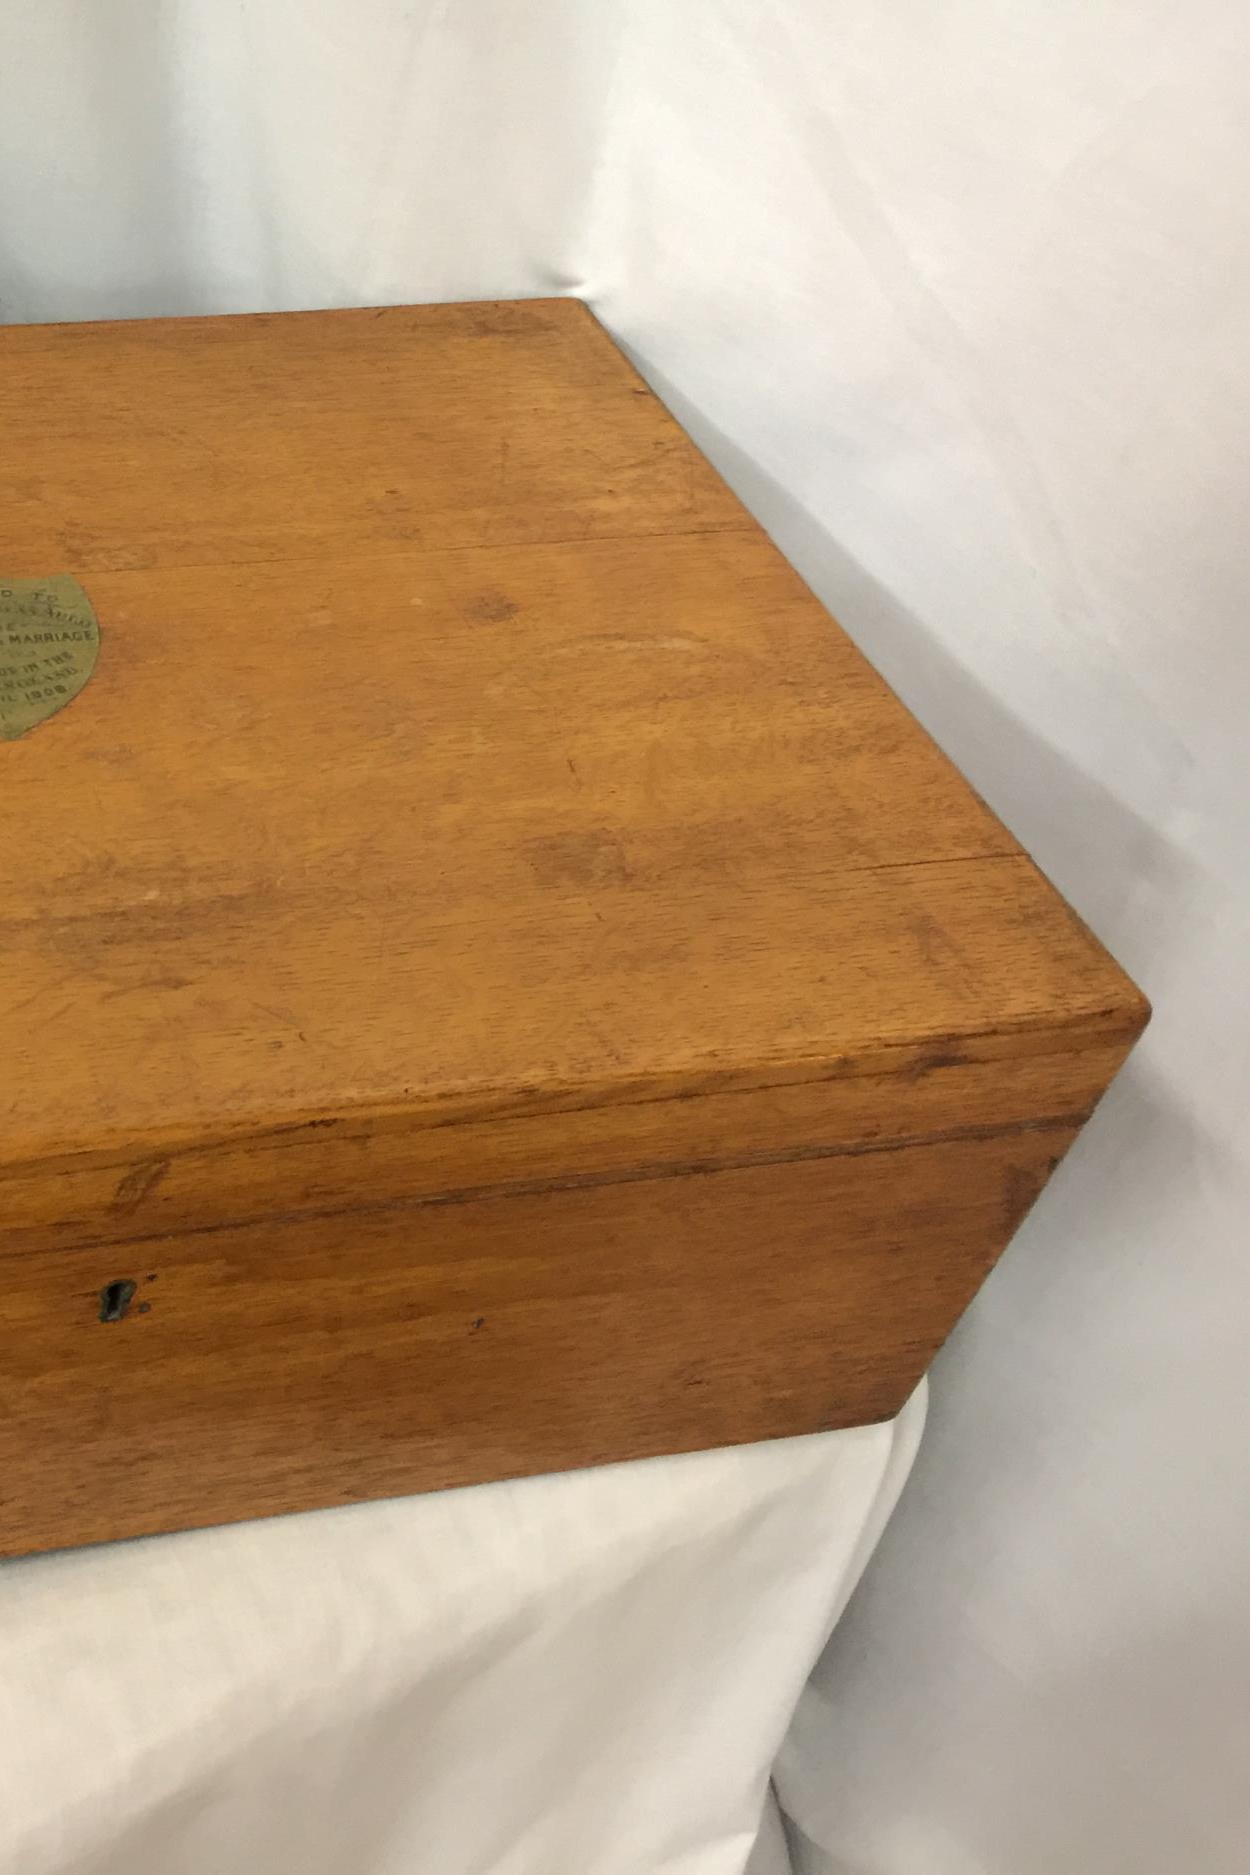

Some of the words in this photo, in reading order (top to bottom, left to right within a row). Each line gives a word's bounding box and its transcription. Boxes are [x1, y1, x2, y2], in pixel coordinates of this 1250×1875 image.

[33, 591, 60, 602] TO
[9, 630, 95, 644] MARRIAGE
[22, 662, 40, 674] IN
[43, 651, 74, 667] THE
